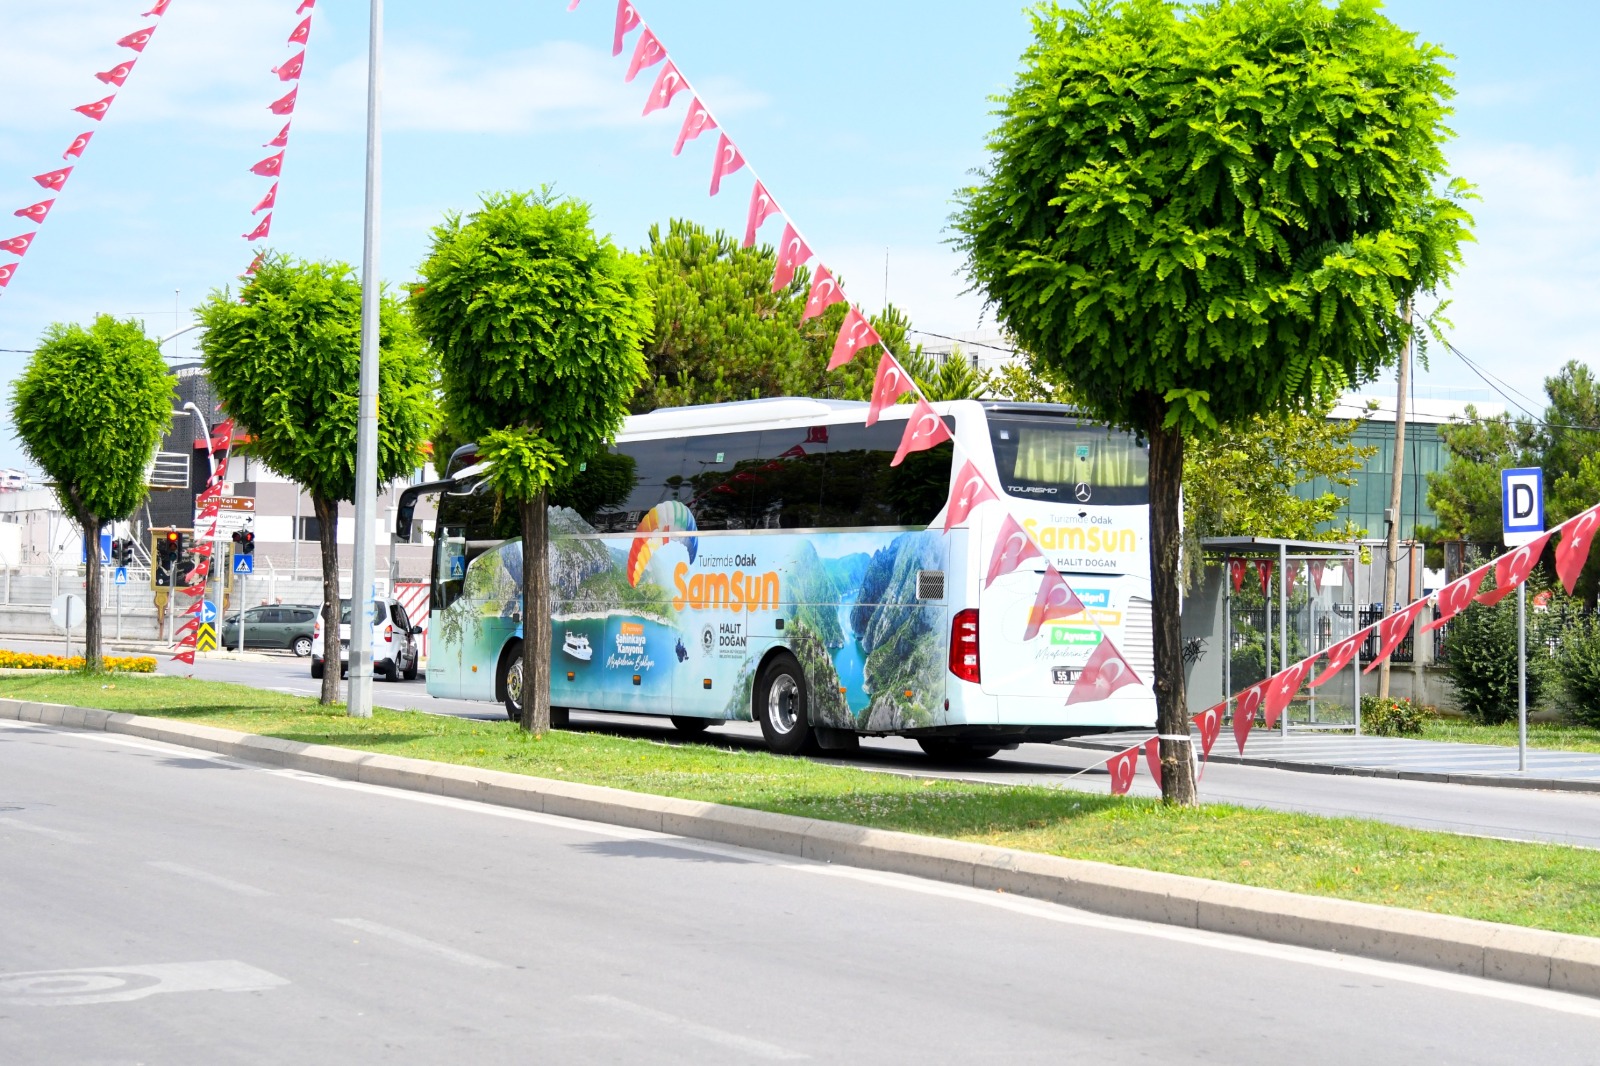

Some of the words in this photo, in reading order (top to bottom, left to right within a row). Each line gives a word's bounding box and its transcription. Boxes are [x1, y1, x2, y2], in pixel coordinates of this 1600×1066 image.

[1007, 485, 1058, 494] TOURISMO
[1512, 483, 1534, 519] D
[1090, 515, 1112, 525] Odak
[698, 554, 733, 567] Turizmde
[735, 554, 757, 567] Odak
[672, 561, 780, 613] Samsun
[719, 635, 746, 647] DOĞAN
[617, 644, 644, 656] Kanyonu
[1057, 671, 1068, 681] 55
